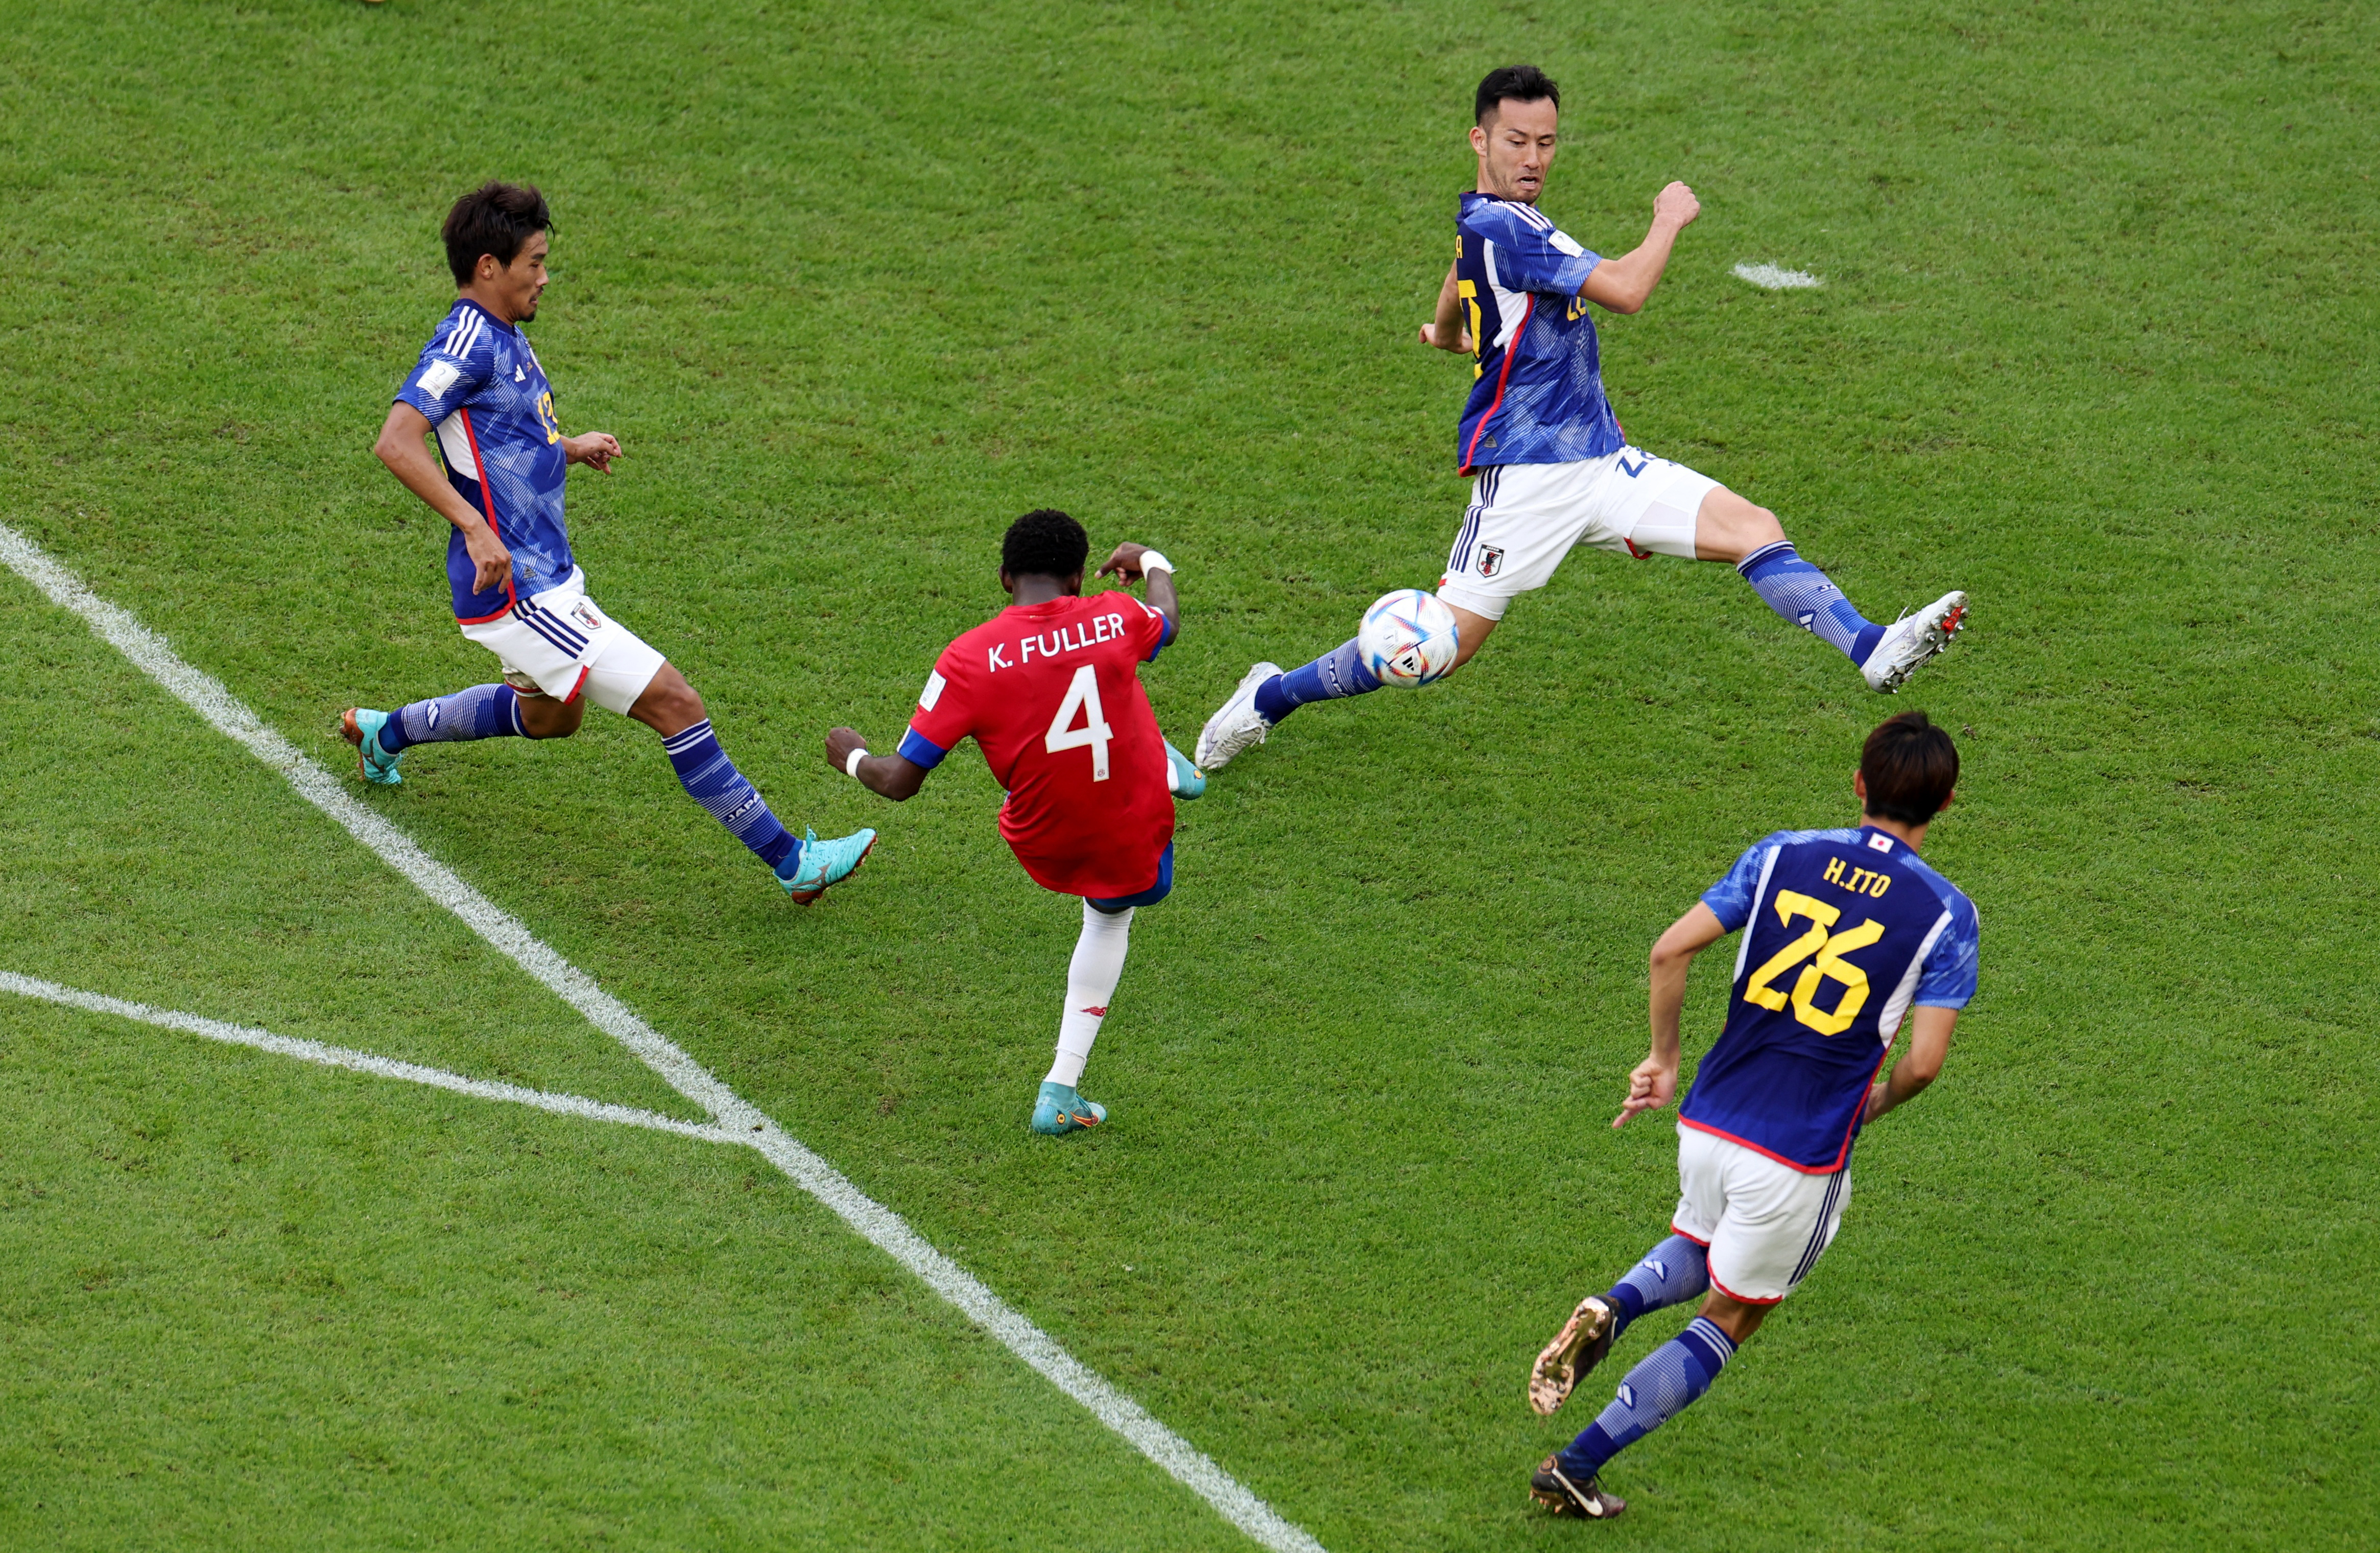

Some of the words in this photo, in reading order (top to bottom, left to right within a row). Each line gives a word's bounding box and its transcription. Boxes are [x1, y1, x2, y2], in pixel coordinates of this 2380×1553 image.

[988, 643, 1013, 673] K.
[1020, 613, 1125, 664] FULLER
[1044, 664, 1114, 783] 4
[1823, 856, 1892, 898] H.ITO
[1743, 889, 1886, 1036] 26
